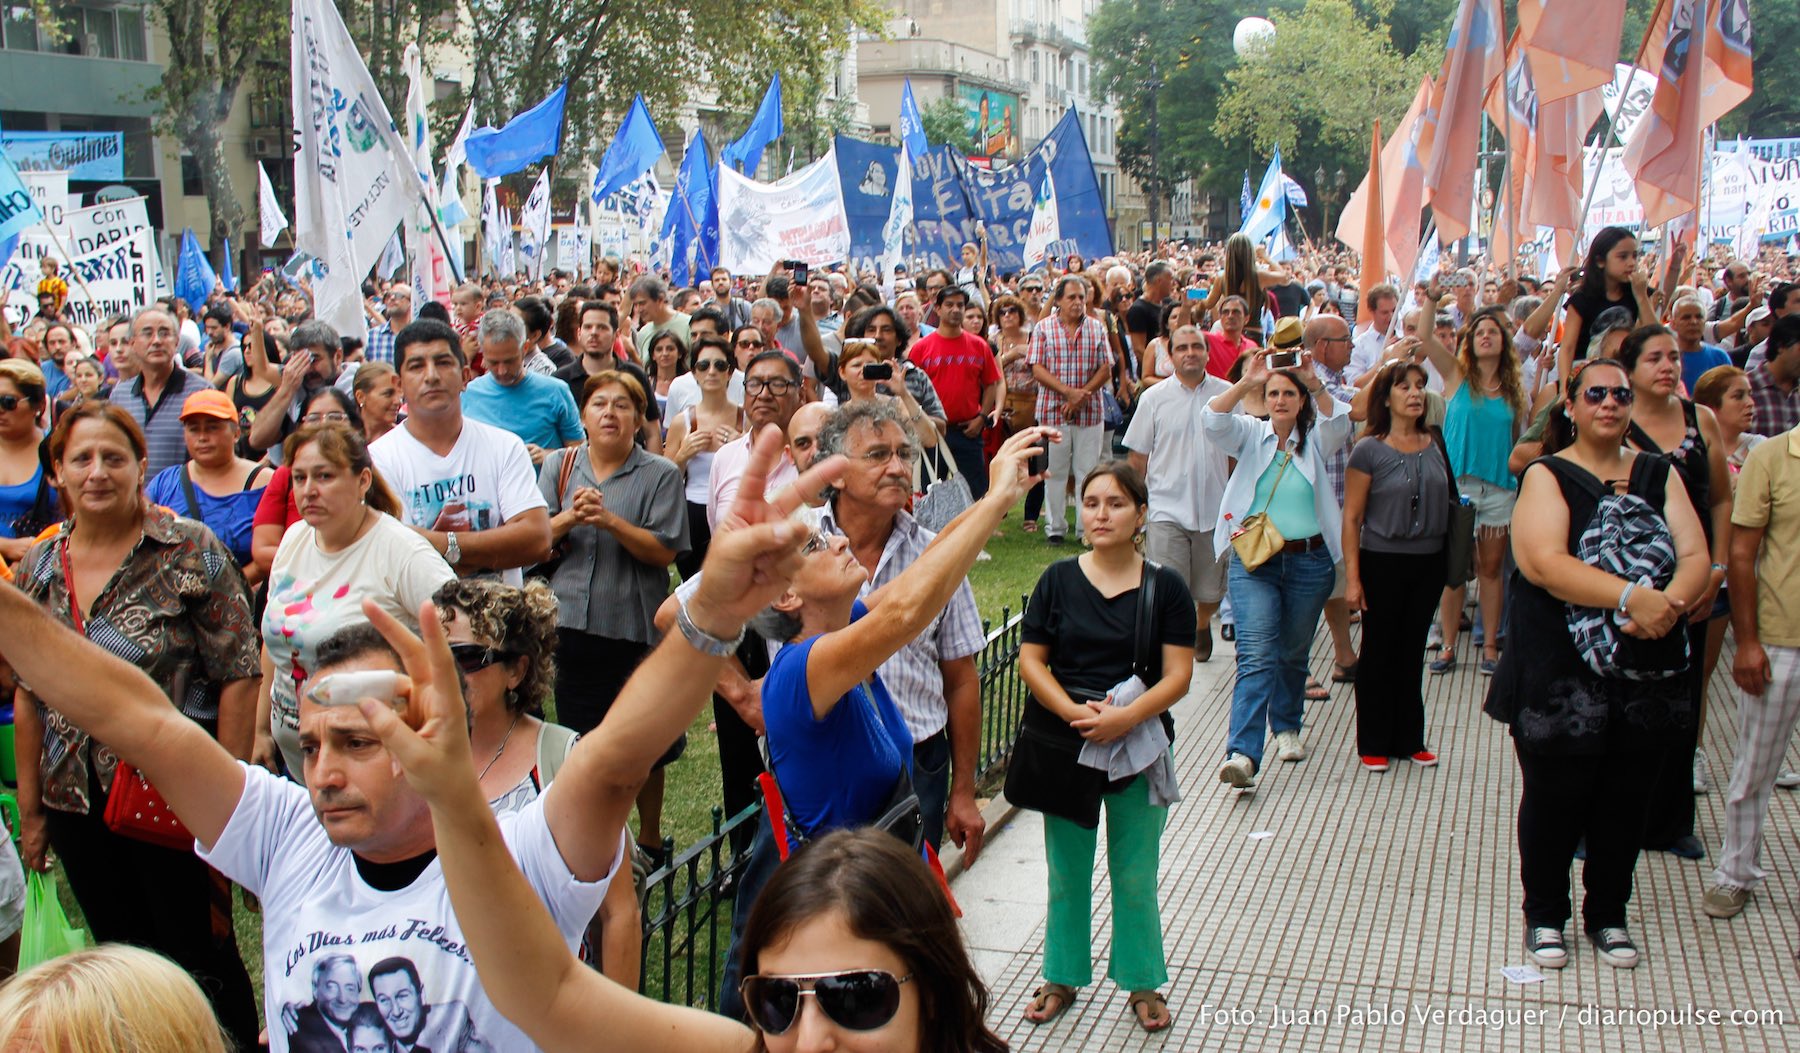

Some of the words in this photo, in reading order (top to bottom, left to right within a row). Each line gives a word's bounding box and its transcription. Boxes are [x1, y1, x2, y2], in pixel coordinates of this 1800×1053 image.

[49, 135, 119, 170] Quilmes
[420, 474, 476, 504] TOKYO
[285, 941, 306, 977] Los
